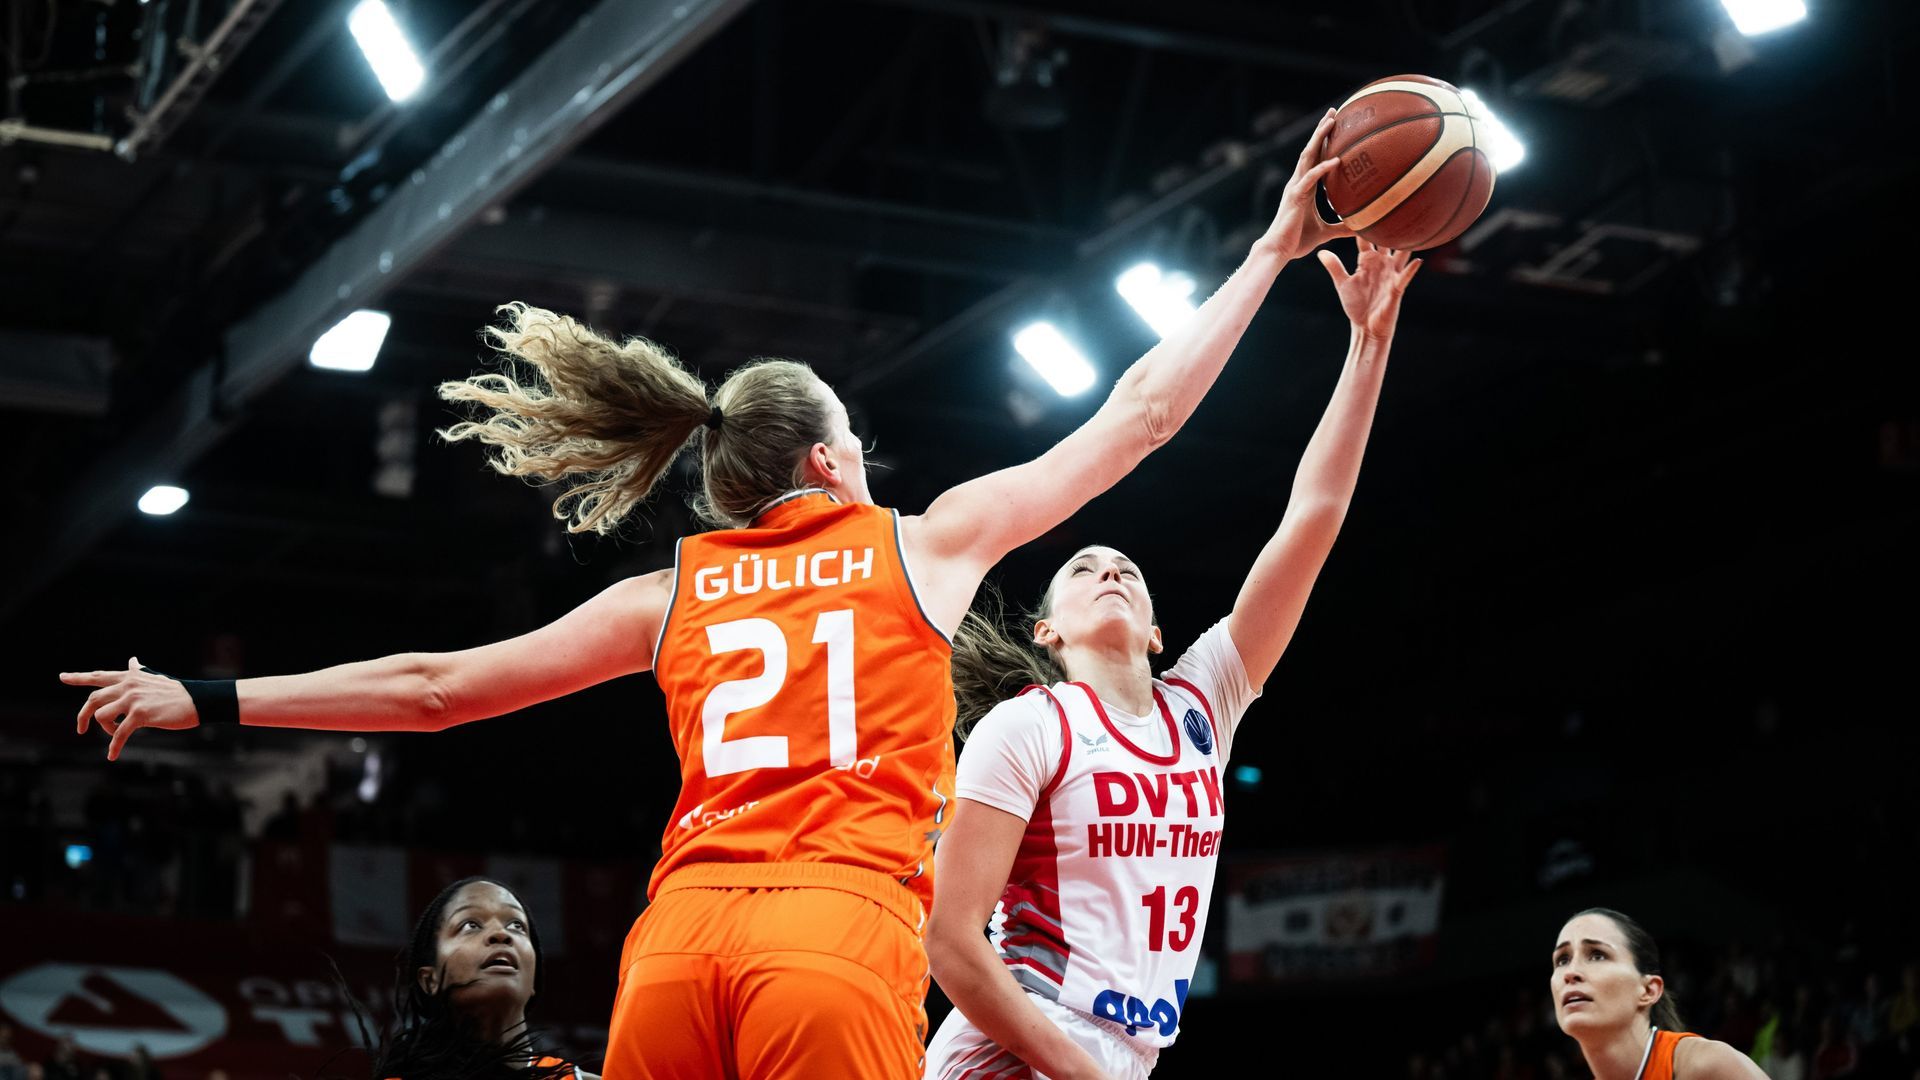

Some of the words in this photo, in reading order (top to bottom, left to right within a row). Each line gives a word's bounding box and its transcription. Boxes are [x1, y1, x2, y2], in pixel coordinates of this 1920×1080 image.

[1343, 151, 1374, 184] FIBA
[694, 547, 874, 602] GÜLICH
[702, 608, 858, 778] 21
[1142, 885, 1199, 952] 13
